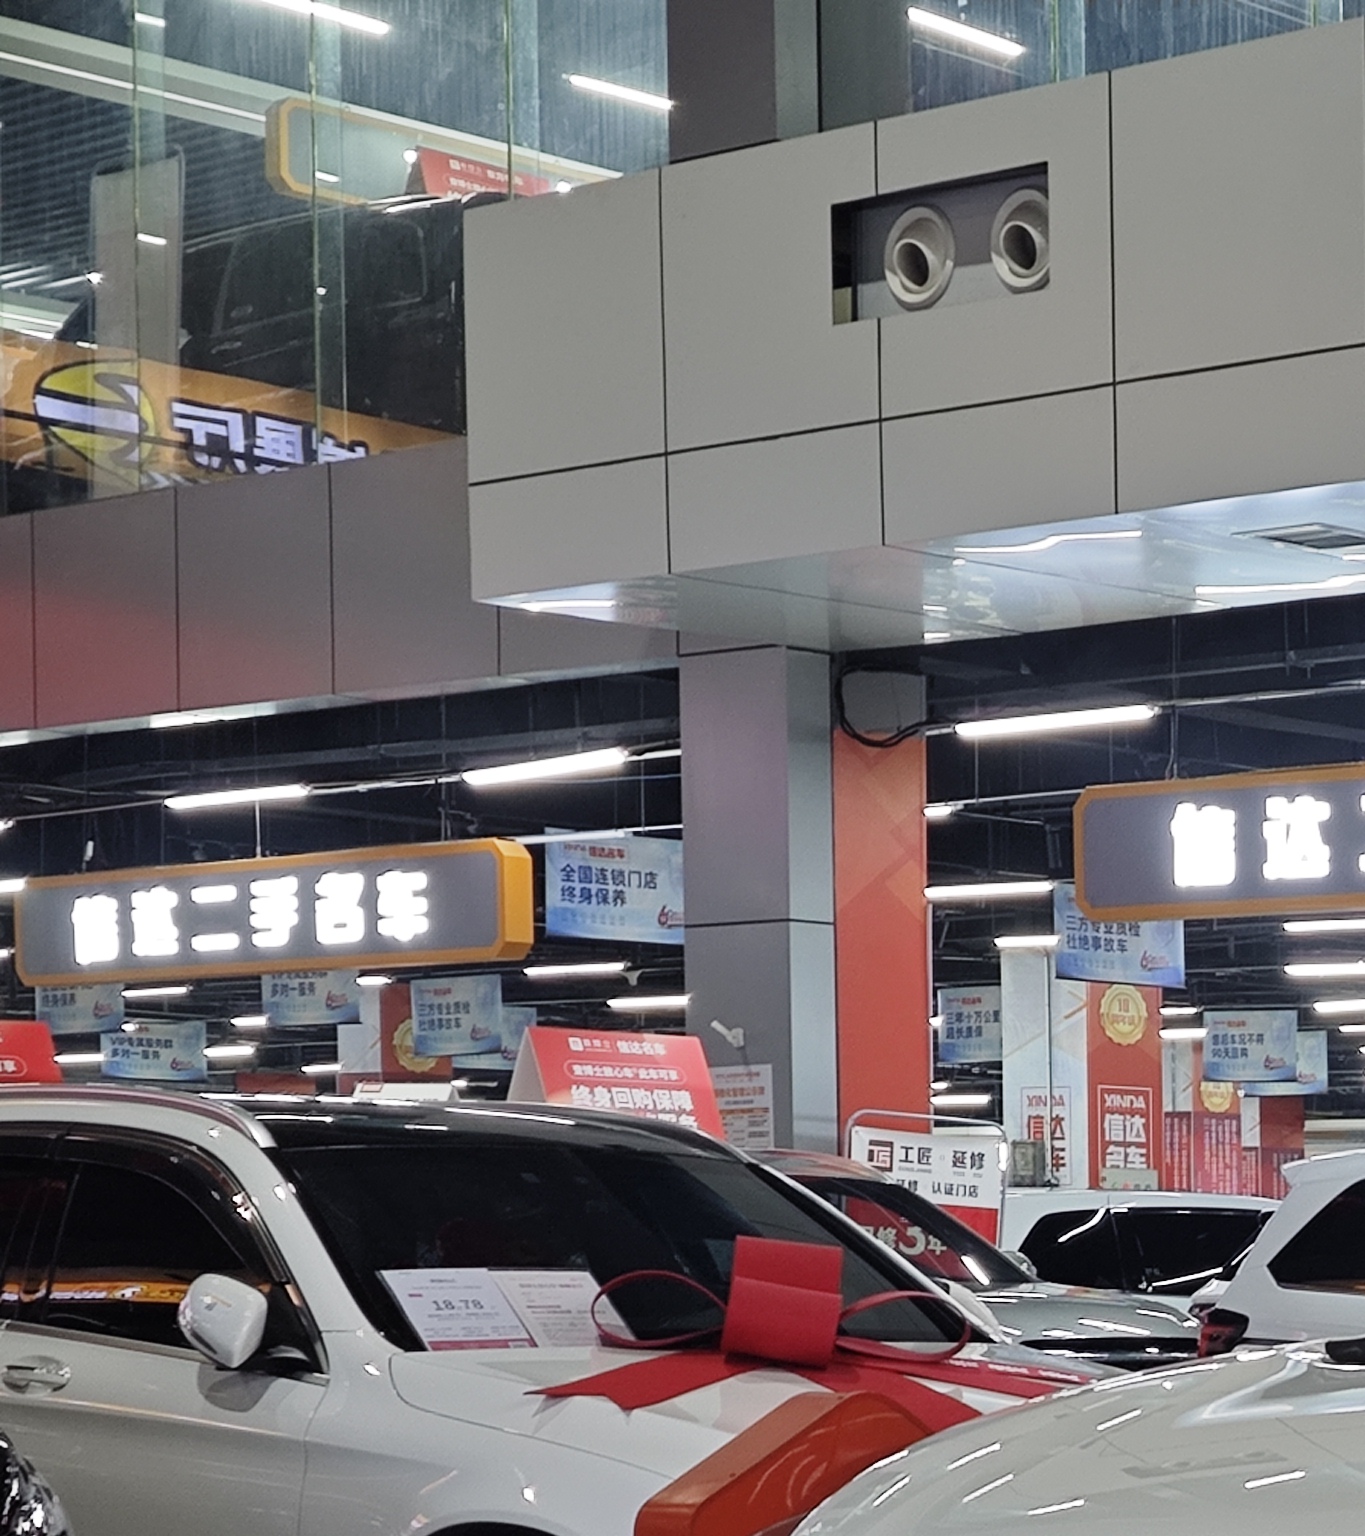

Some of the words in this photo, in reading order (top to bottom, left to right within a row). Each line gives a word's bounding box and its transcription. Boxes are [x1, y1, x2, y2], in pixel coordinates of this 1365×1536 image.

[560, 863, 658, 890] 全国连锁门店
[560, 885, 627, 907] 终身保养
[1066, 934, 1128, 954] 杜绝事故车
[570, 1084, 694, 1112] 终身回购保障
[1103, 1092, 1146, 1110] XINDA
[1102, 1111, 1147, 1142] 信达
[898, 1145, 933, 1166] 工匠
[952, 1149, 985, 1170] 延修
[932, 1181, 979, 1198] 认证门店
